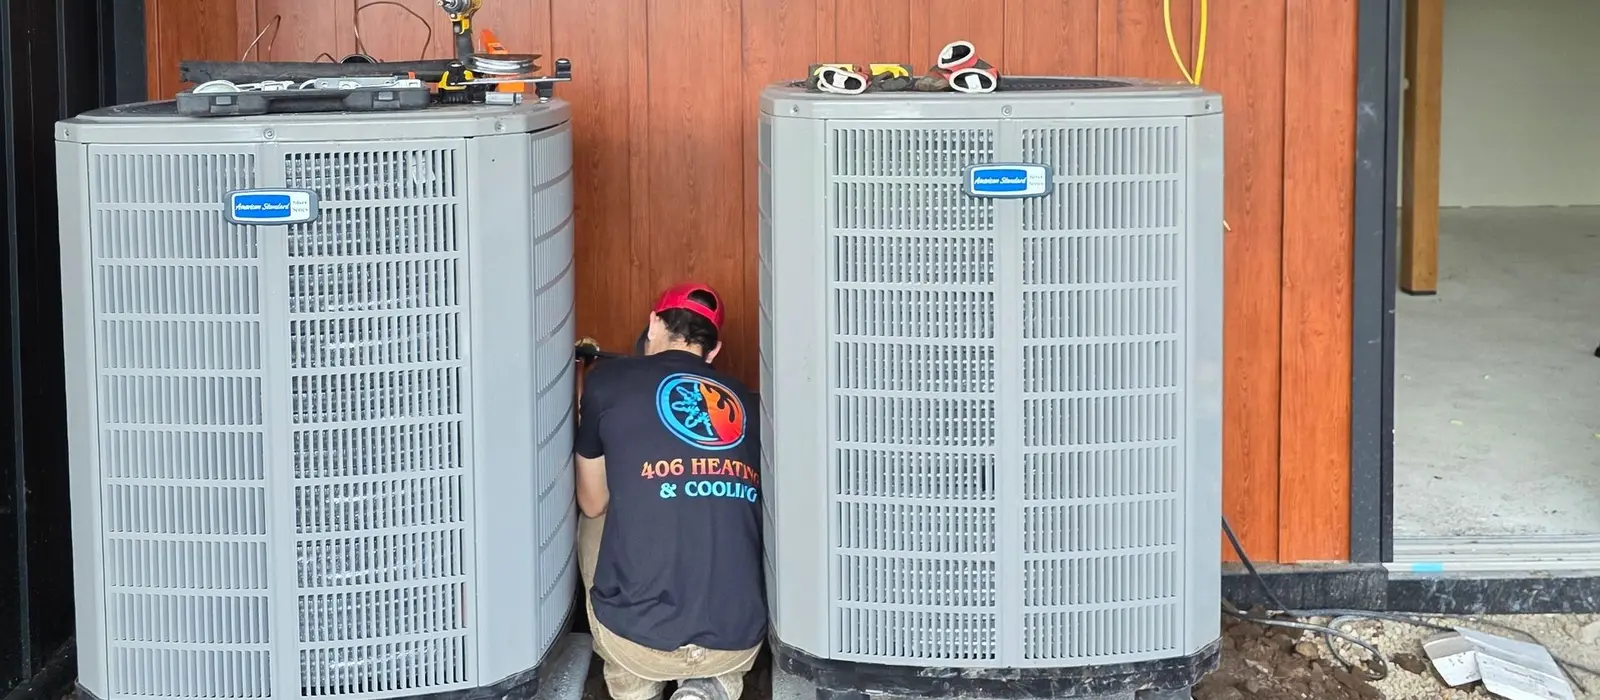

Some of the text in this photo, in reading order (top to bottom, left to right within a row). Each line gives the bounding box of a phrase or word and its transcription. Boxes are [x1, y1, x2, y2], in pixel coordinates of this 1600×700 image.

[974, 176, 1000, 184] American
[1000, 176, 1027, 184] Standard
[262, 202, 290, 210] Standard
[641, 458, 685, 479] 406
[659, 482, 677, 498] &
